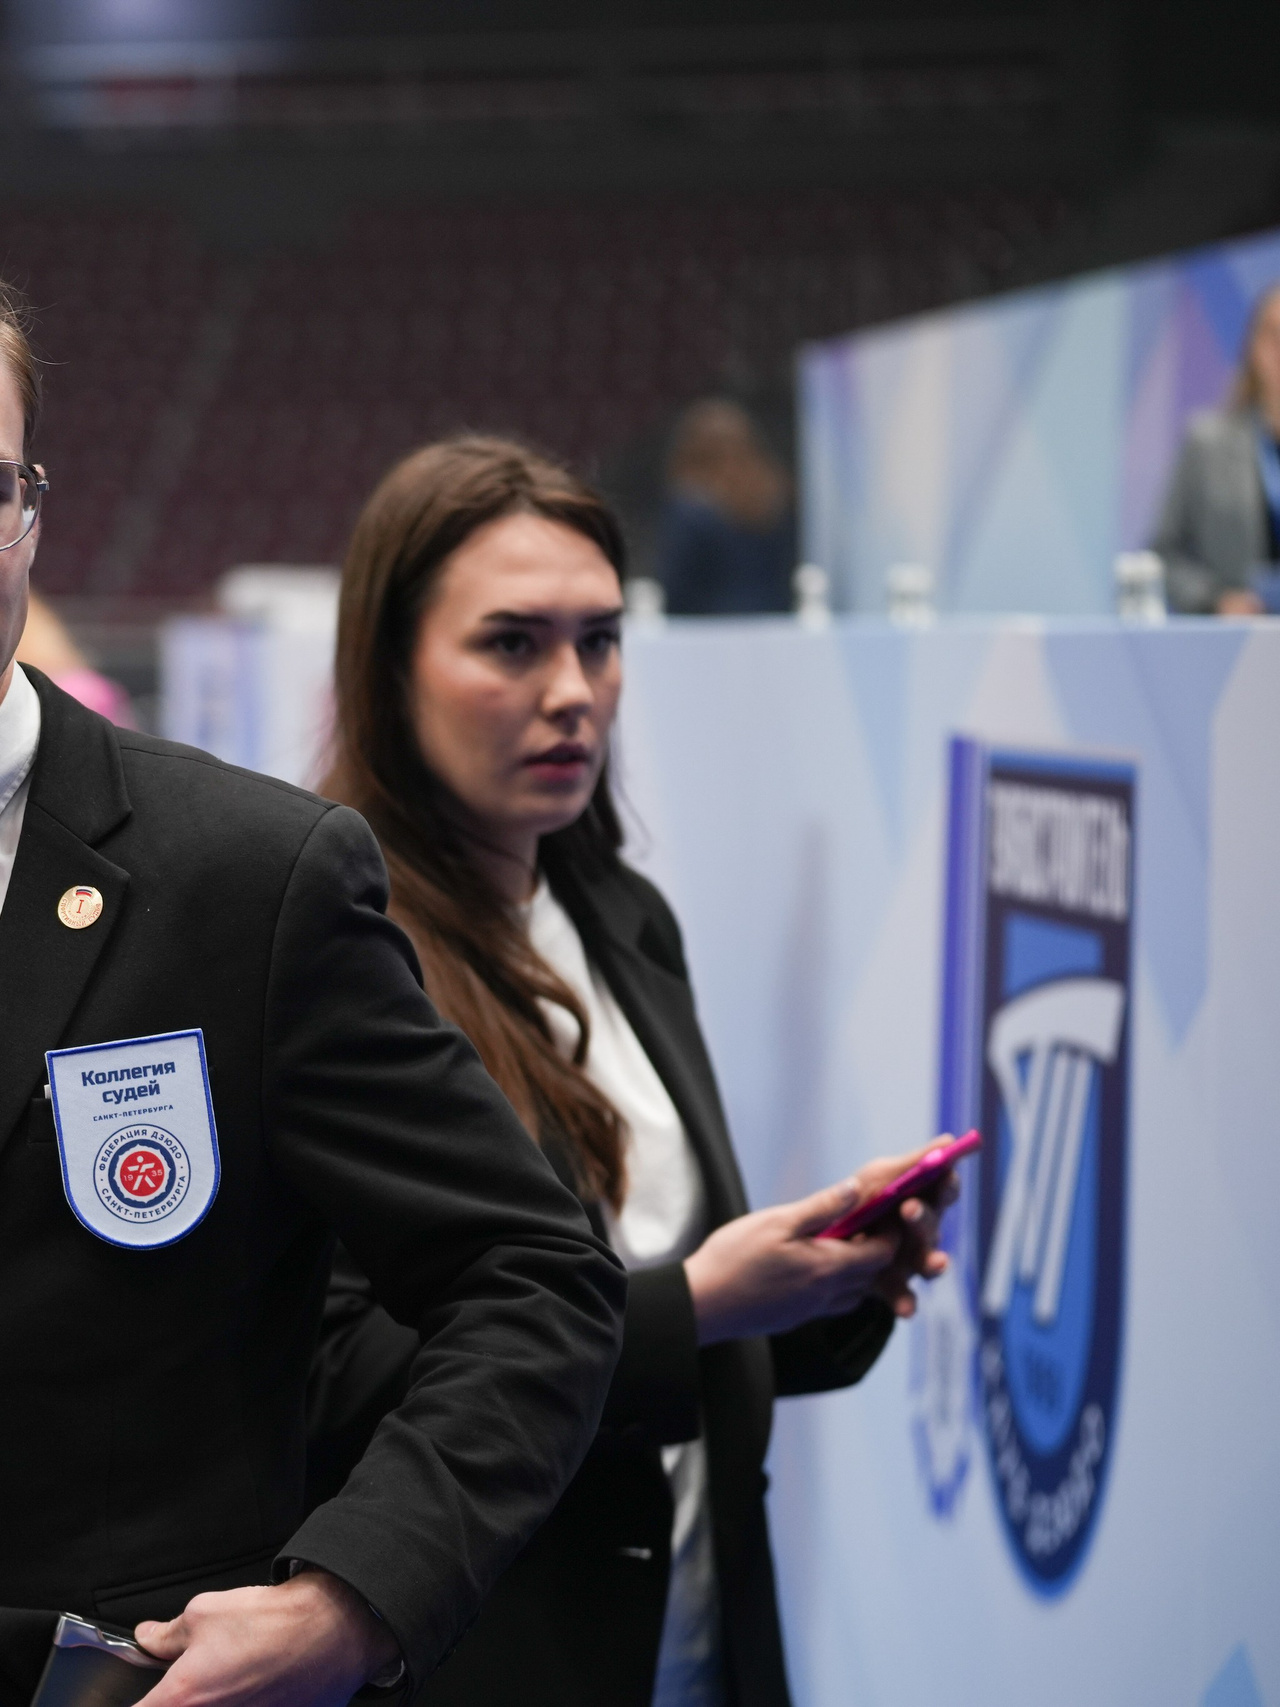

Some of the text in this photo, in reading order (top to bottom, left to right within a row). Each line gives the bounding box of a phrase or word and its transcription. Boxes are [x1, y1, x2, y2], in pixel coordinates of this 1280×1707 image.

[81, 1061, 176, 1087] Коллегия
[102, 1080, 161, 1105] судей
[93, 1104, 174, 1122] САНКТ-ПЕТЕРБУРГА
[99, 1128, 182, 1171] ФЕДЕРАЦИЯ ДЗЮДО
[102, 1175, 186, 1218] САНКТ-ПЕТЕРБУРГА
